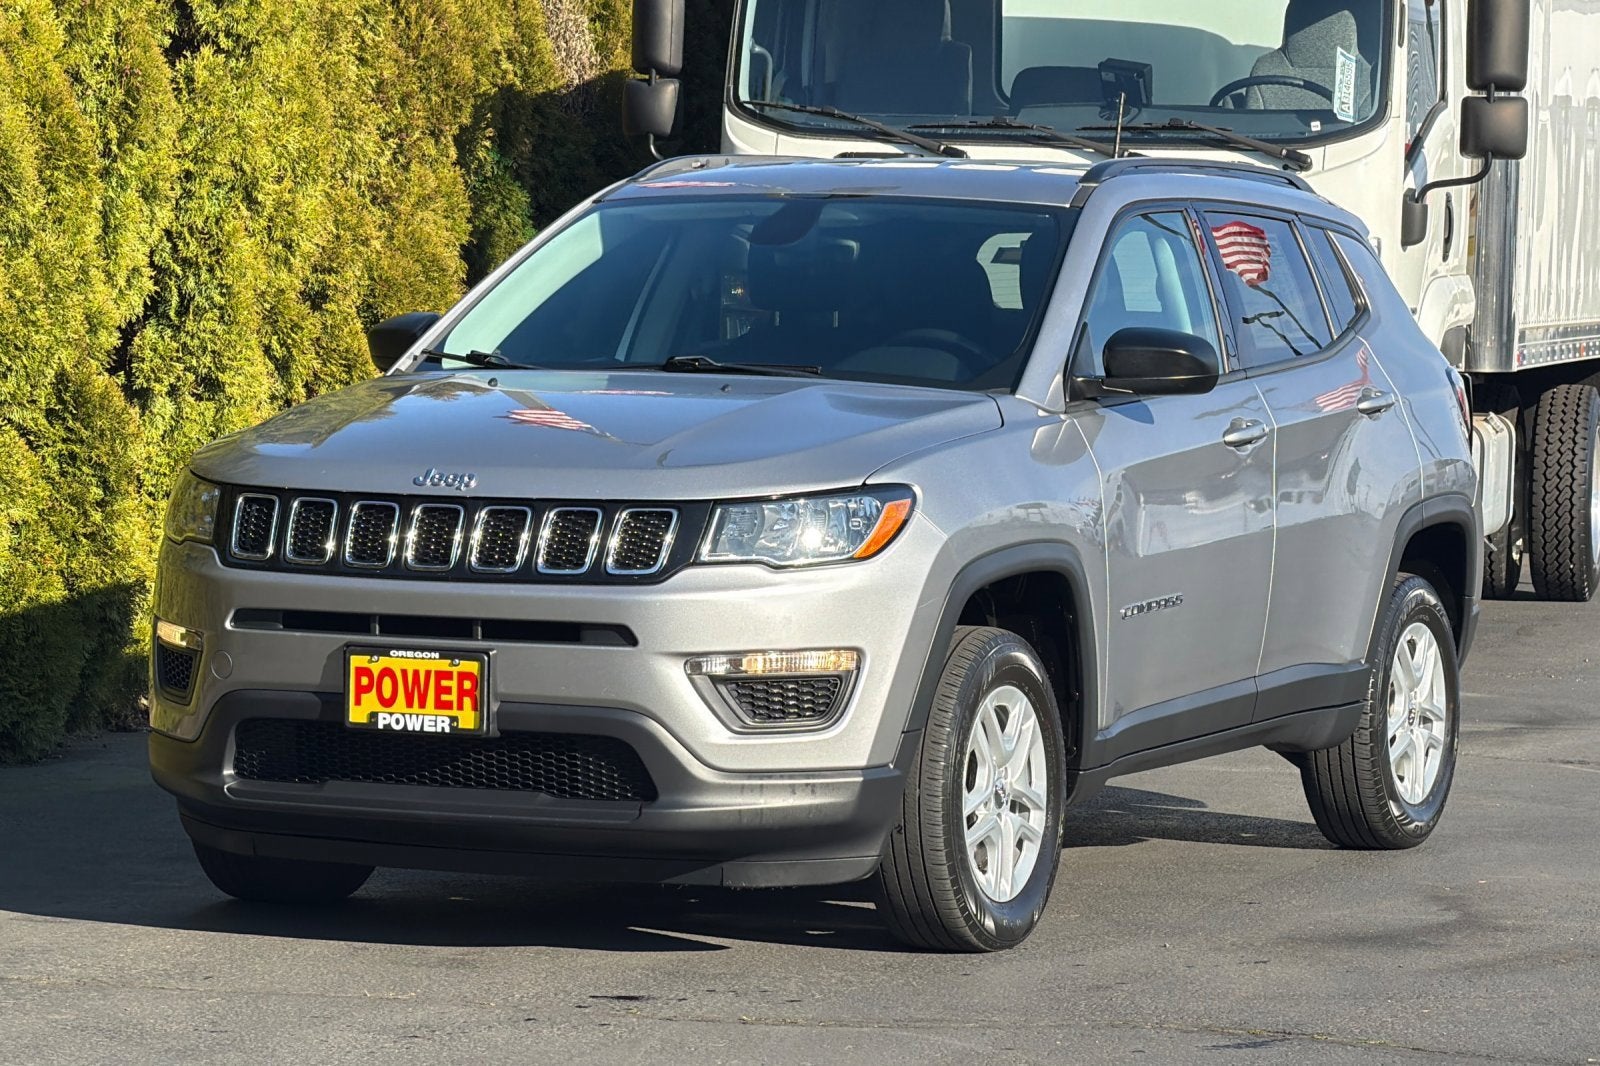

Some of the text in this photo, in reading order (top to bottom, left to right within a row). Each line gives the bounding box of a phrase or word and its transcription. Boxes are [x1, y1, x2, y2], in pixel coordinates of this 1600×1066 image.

[412, 468, 477, 491] Jeep
[1120, 593, 1183, 620] COMPASS
[389, 650, 440, 660] OREGON
[354, 666, 479, 712] POWER
[377, 712, 451, 733] POWER
